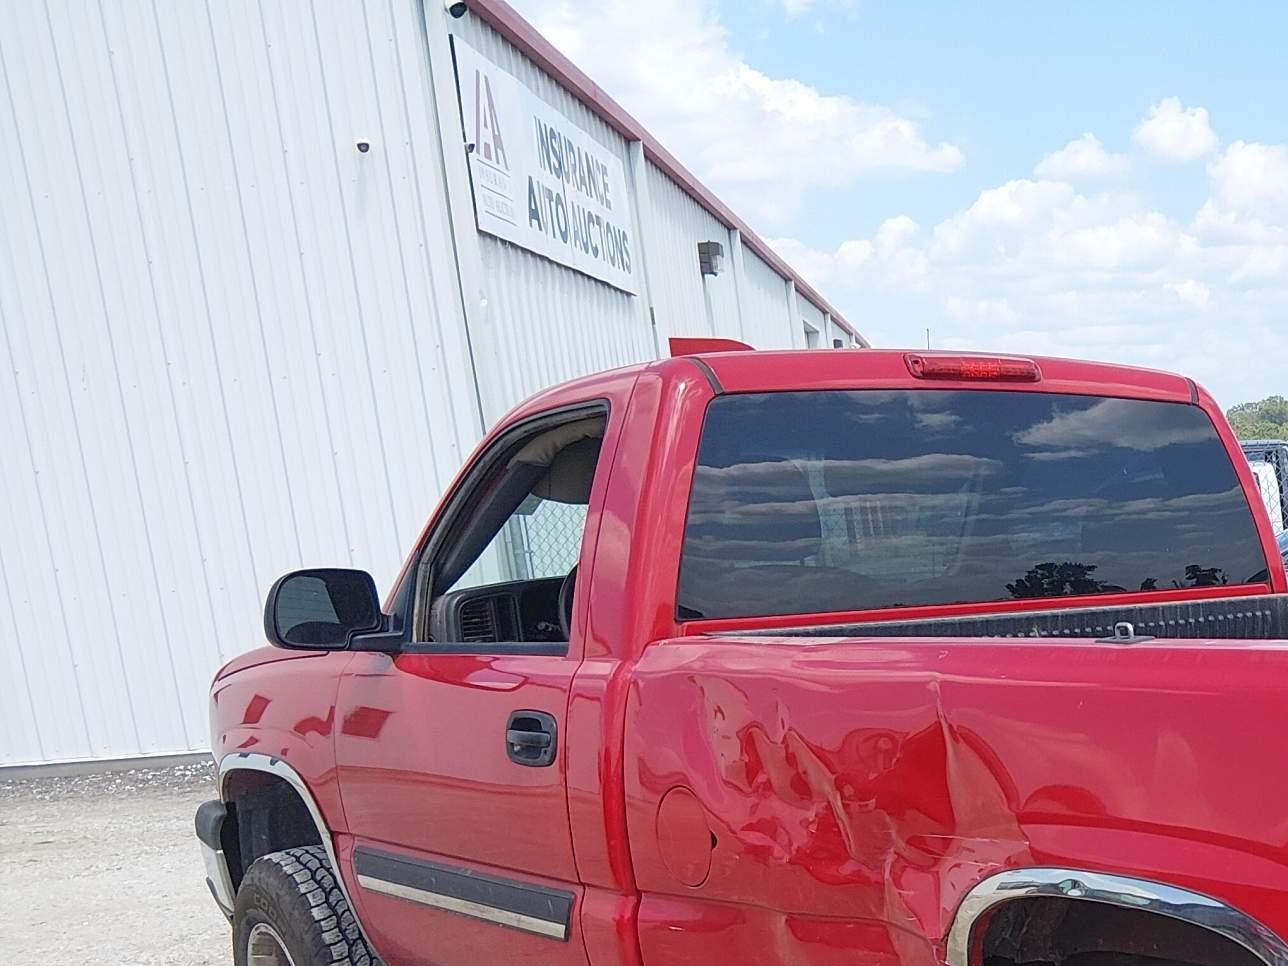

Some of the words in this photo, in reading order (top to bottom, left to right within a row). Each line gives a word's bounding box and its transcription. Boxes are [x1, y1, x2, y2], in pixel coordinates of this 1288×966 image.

[534, 115, 612, 210] INSURANCE
[528, 176, 569, 244] AUTO
[571, 201, 632, 275] AUCTIONS
